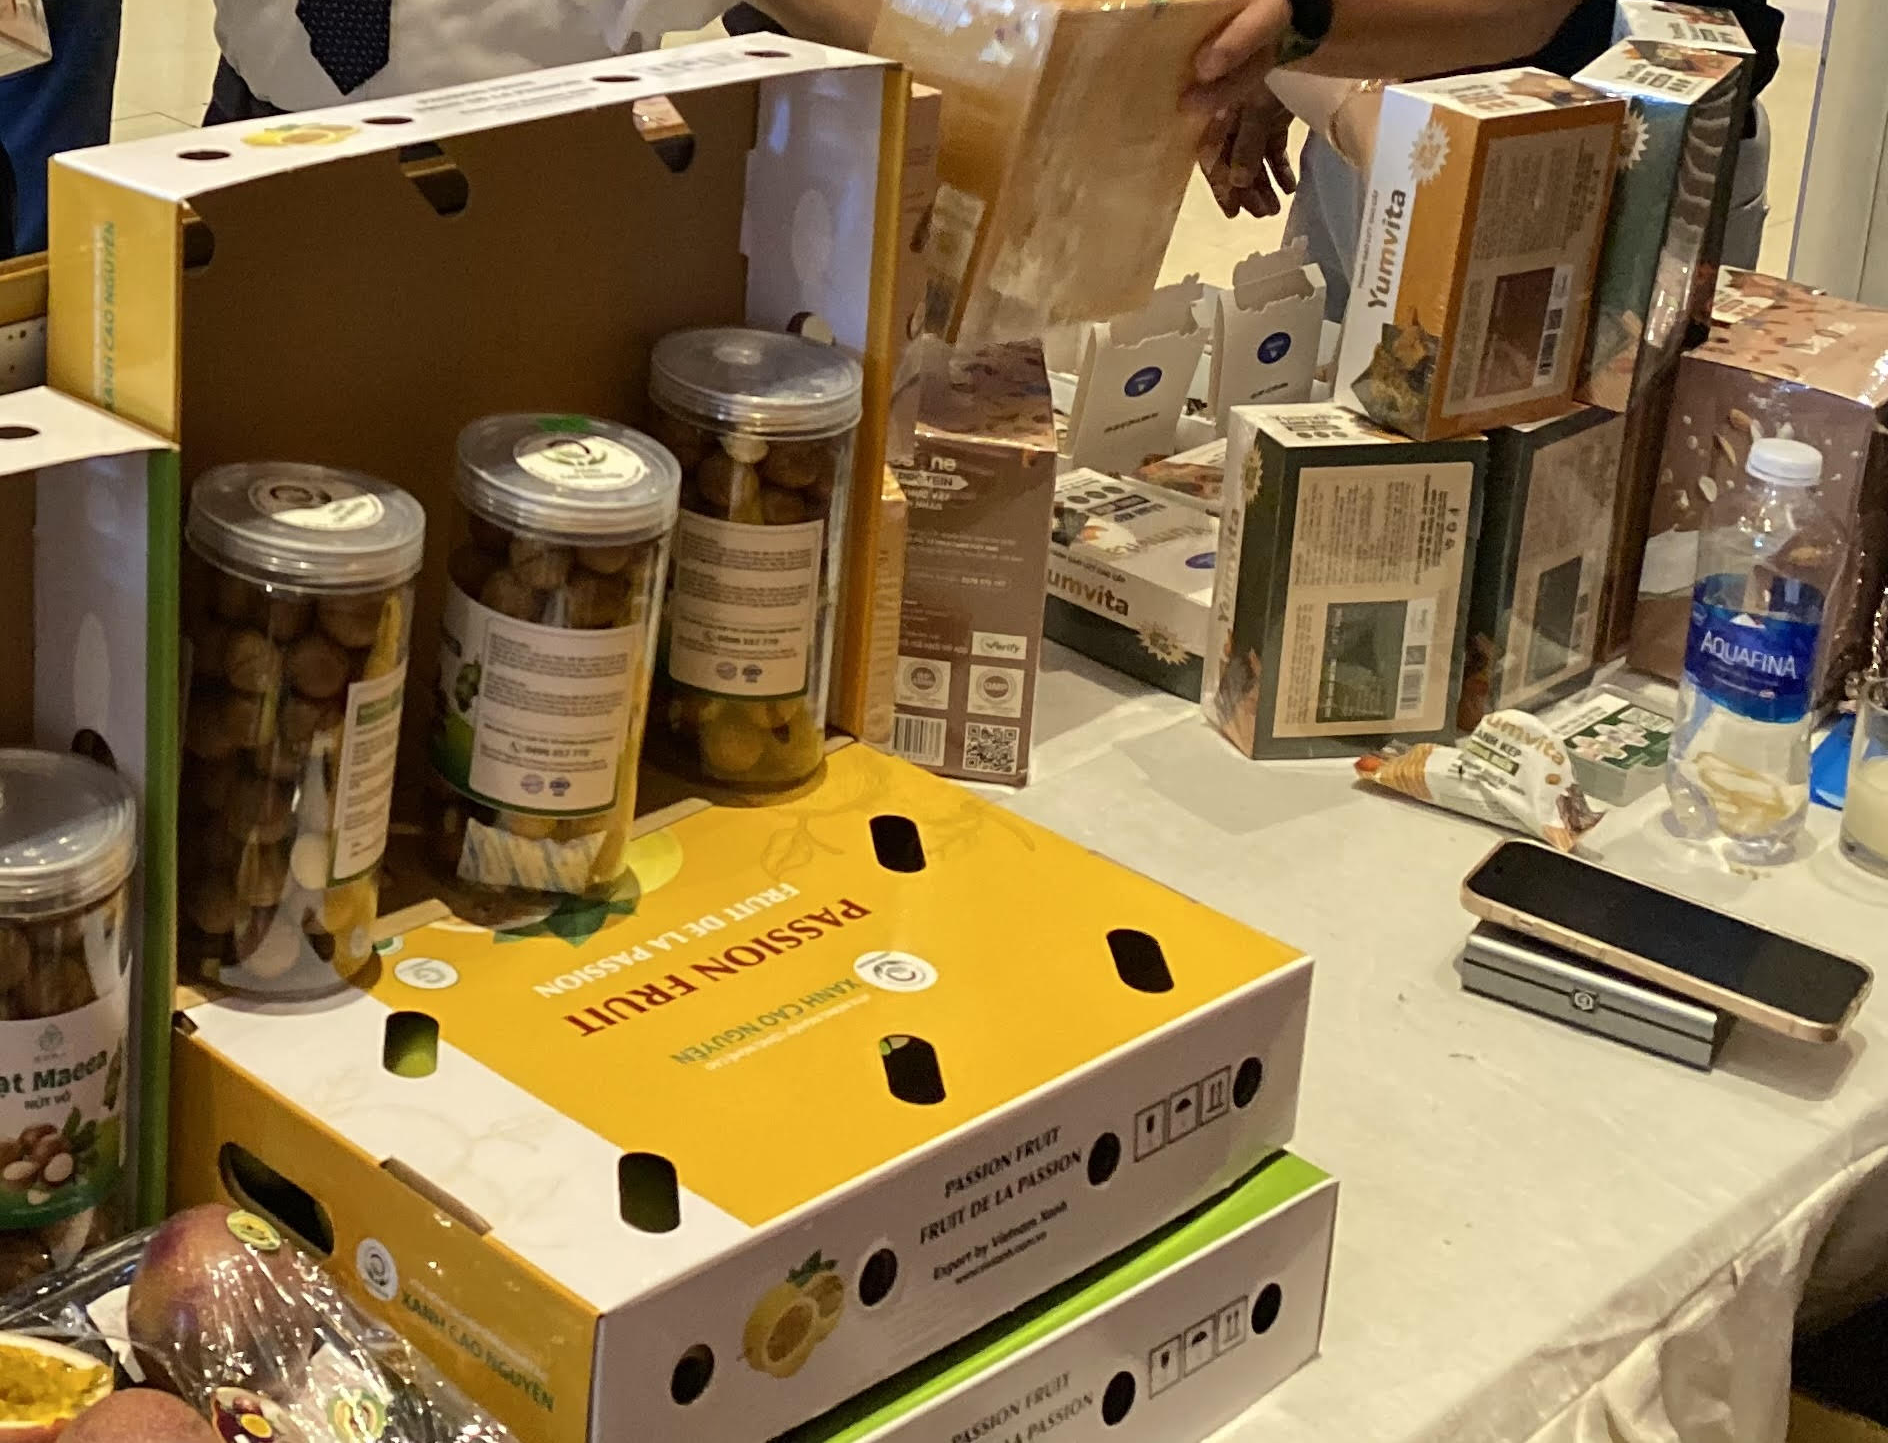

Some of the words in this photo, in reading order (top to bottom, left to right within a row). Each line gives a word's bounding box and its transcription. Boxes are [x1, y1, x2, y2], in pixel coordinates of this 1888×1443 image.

[1367, 189, 1407, 309] Yumvita
[103, 308, 116, 352] CAO
[1047, 566, 1130, 617] umvita
[1700, 630, 1798, 680] AQUAFINA
[1486, 716, 1565, 766] umvita
[723, 882, 801, 920] FRUIT
[647, 930, 690, 952] LA
[683, 915, 727, 939] DE
[690, 898, 873, 983] PASSION
[532, 950, 654, 999] PASSION
[809, 977, 858, 1009] XANH
[563, 974, 699, 1037] FRUIT
[755, 997, 806, 1028] CAO
[668, 1019, 761, 1066] NGUYÊN
[944, 1151, 1012, 1199] PASSION
[1016, 1125, 1062, 1163] FRUIT
[920, 1206, 966, 1245] FRUIT
[971, 1194, 992, 1219] DE
[995, 1183, 1014, 1206] LA
[1017, 1148, 1082, 1194] PASSION
[1025, 1369, 1072, 1410] FRUIT
[1026, 1390, 1095, 1442] PASSION
